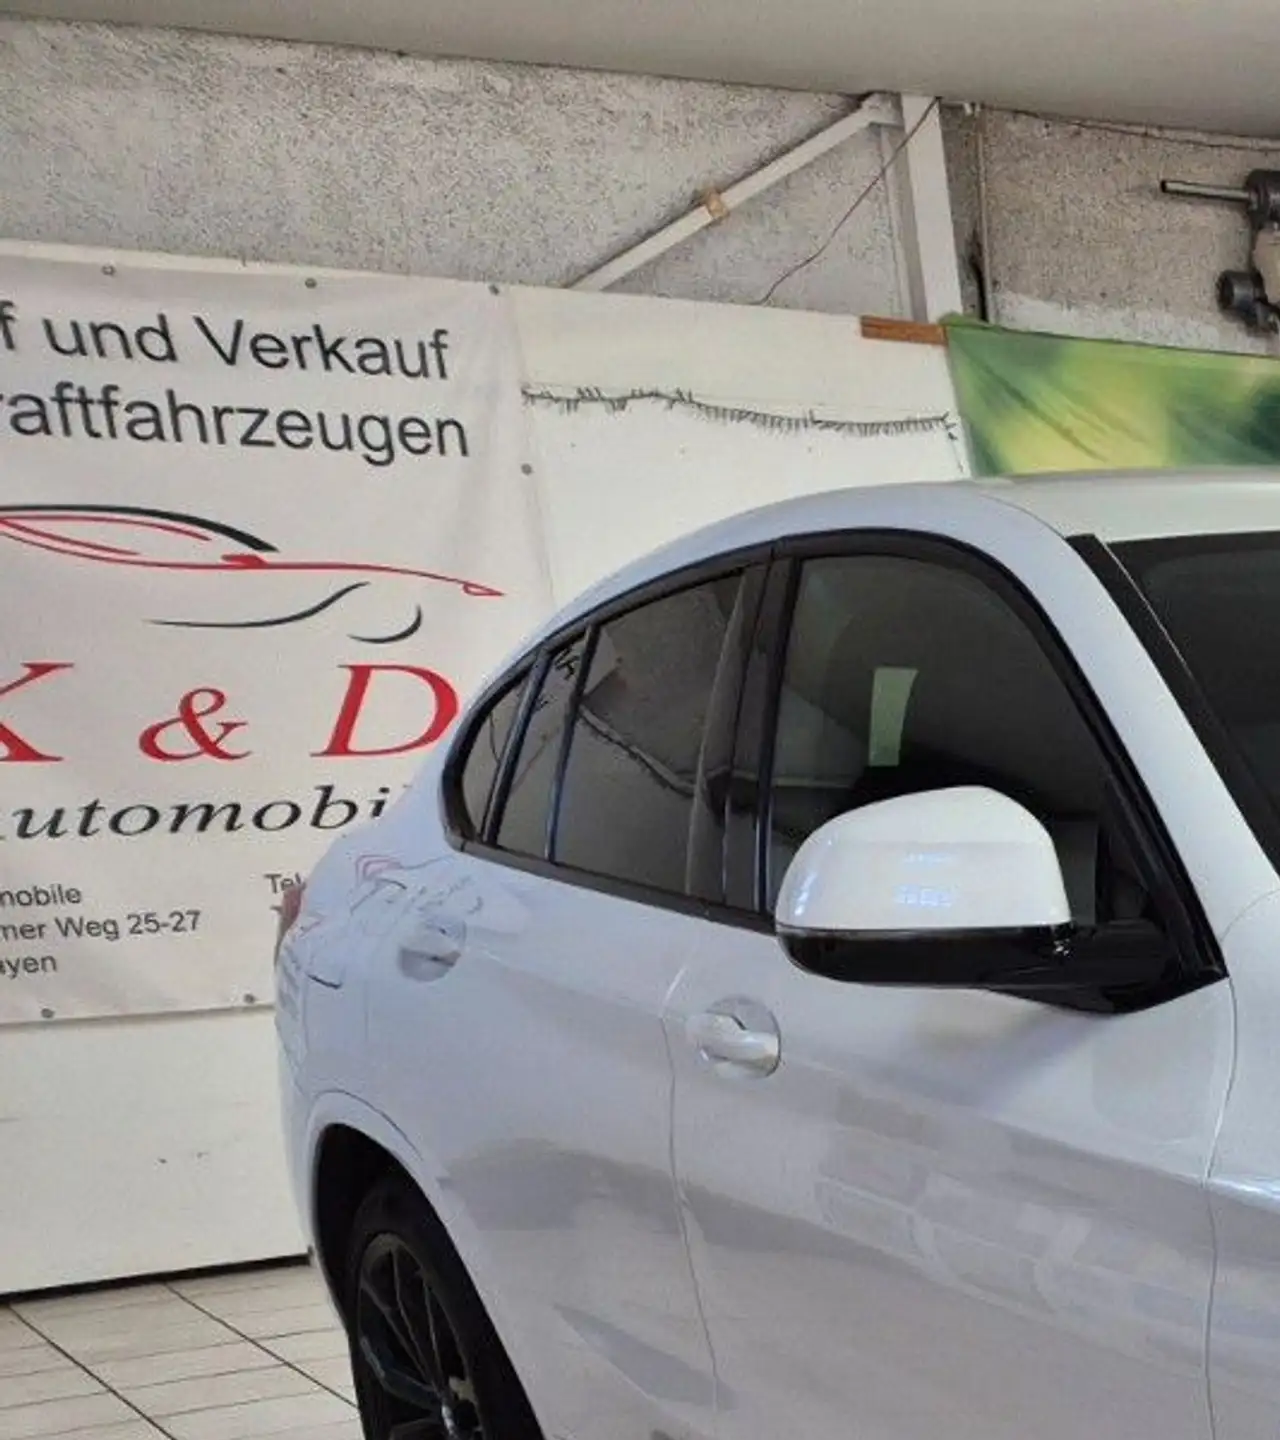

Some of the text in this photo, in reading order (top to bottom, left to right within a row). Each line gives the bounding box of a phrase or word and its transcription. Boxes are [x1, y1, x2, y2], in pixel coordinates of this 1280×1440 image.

[42, 313, 178, 362] und
[193, 315, 450, 380] Verkauf
[0, 381, 470, 467] aftfahrzeugen
[138, 688, 253, 762] &
[309, 665, 459, 758] D
[0, 784, 411, 841] utomobi
[54, 916, 120, 941] Weg
[126, 910, 202, 936] 25-27
